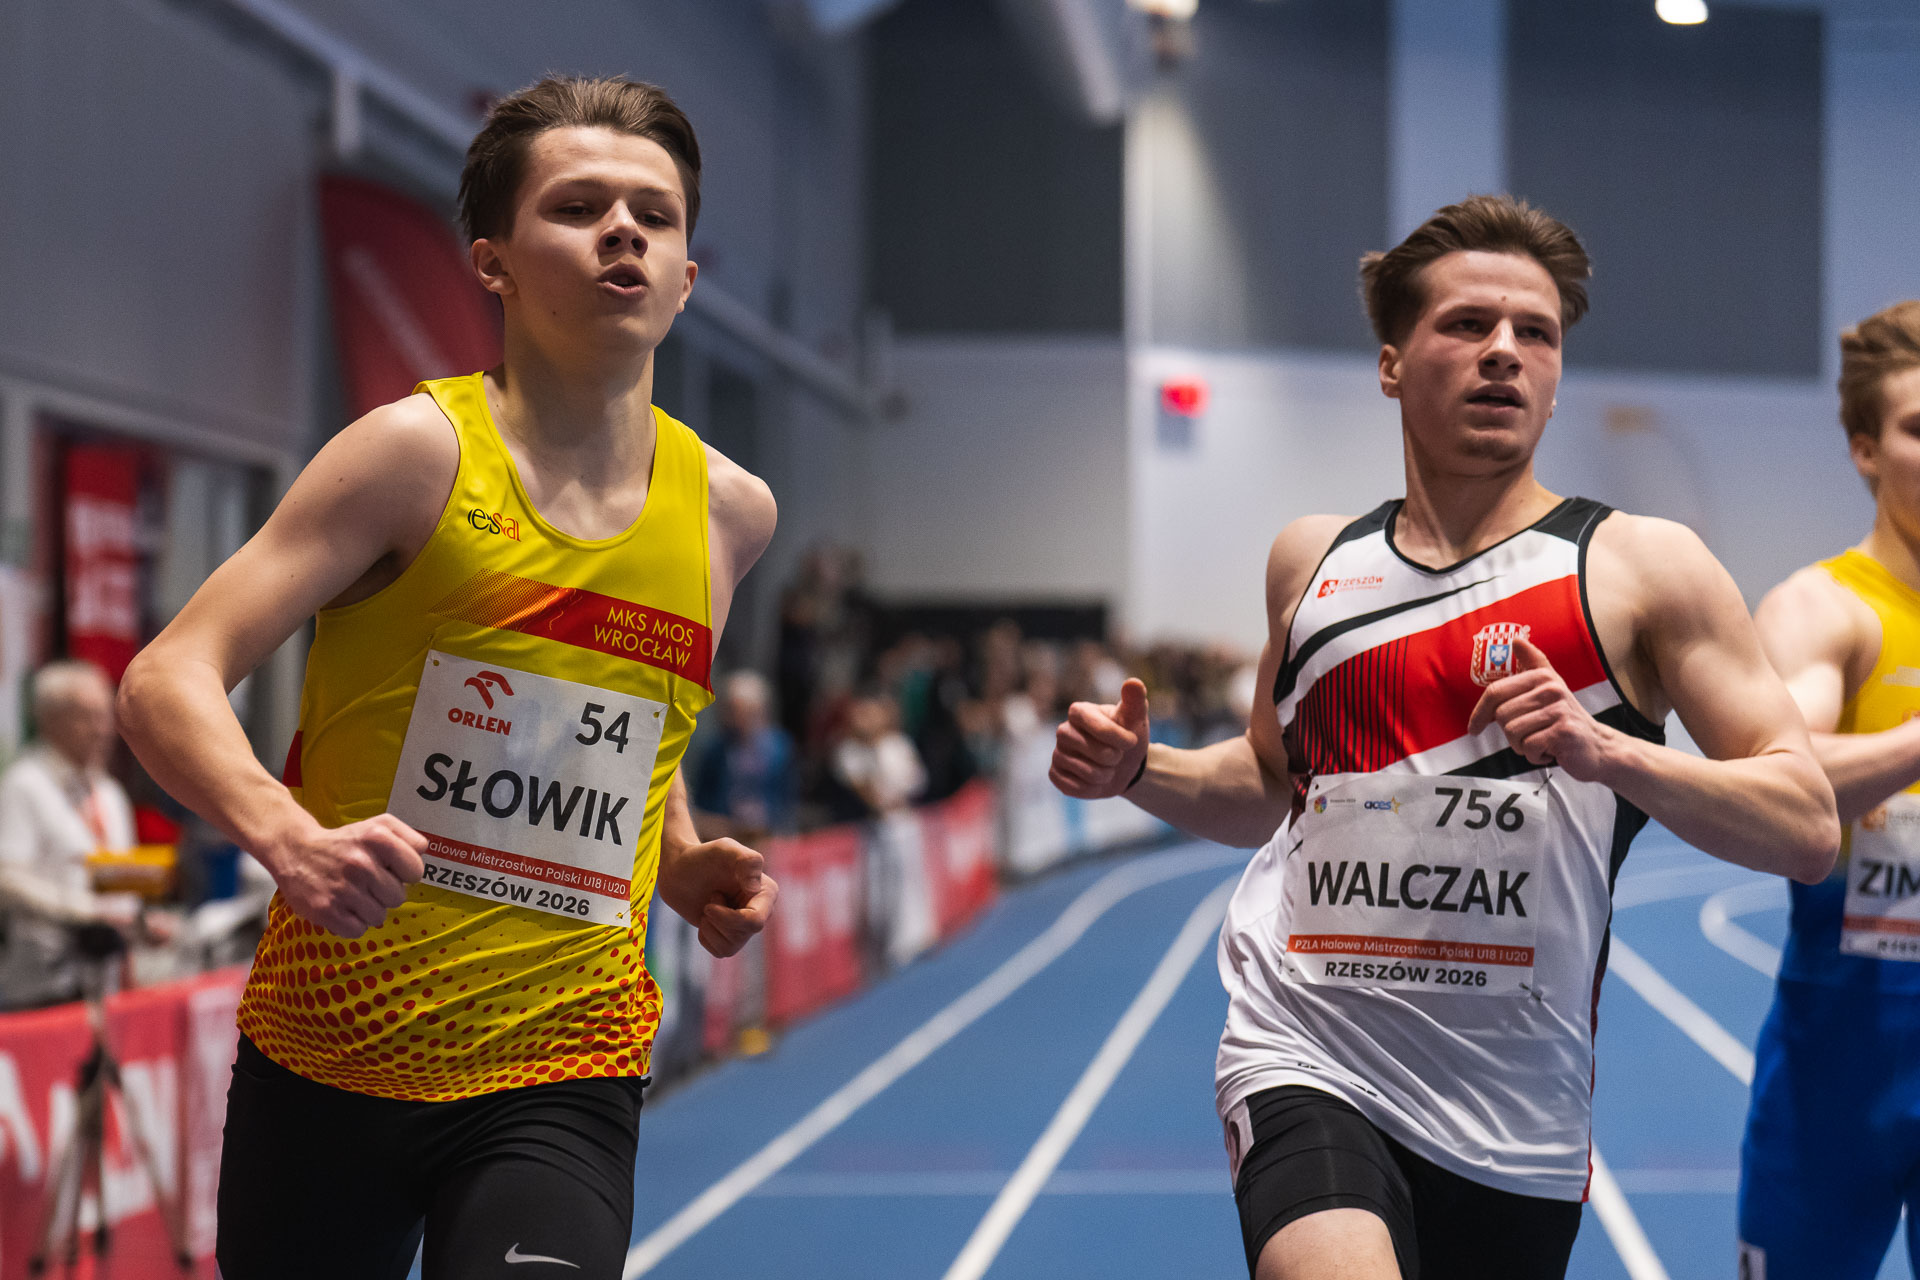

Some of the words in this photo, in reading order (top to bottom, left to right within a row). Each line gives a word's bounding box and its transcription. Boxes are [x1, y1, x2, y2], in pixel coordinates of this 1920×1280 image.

[593, 624, 691, 669] WROCŁAW
[606, 606, 647, 632] MKS
[652, 617, 694, 647] MOS
[447, 707, 512, 736] ORLEN
[575, 701, 631, 754] 54
[416, 752, 630, 846] SŁOWIK
[1364, 800, 1392, 810] aces
[1435, 787, 1525, 832] 756
[422, 862, 534, 903] RZESZÓW
[536, 889, 590, 916] 2026
[427, 839, 468, 859] alowe
[470, 850, 543, 876] Mistrzostwa
[545, 867, 581, 885] Polski
[583, 875, 602, 889] U18
[607, 881, 626, 896] U20
[1308, 861, 1530, 917] WALCZAK
[1295, 939, 1318, 950] PZLA
[1320, 939, 1361, 951] Halowe
[1364, 941, 1437, 957] Mistrzostwa
[1440, 946, 1475, 959] Polski
[1477, 948, 1497, 960] U18
[1505, 951, 1528, 963] U20
[1325, 961, 1430, 983] RZESZÓW
[1435, 968, 1488, 987] 2026
